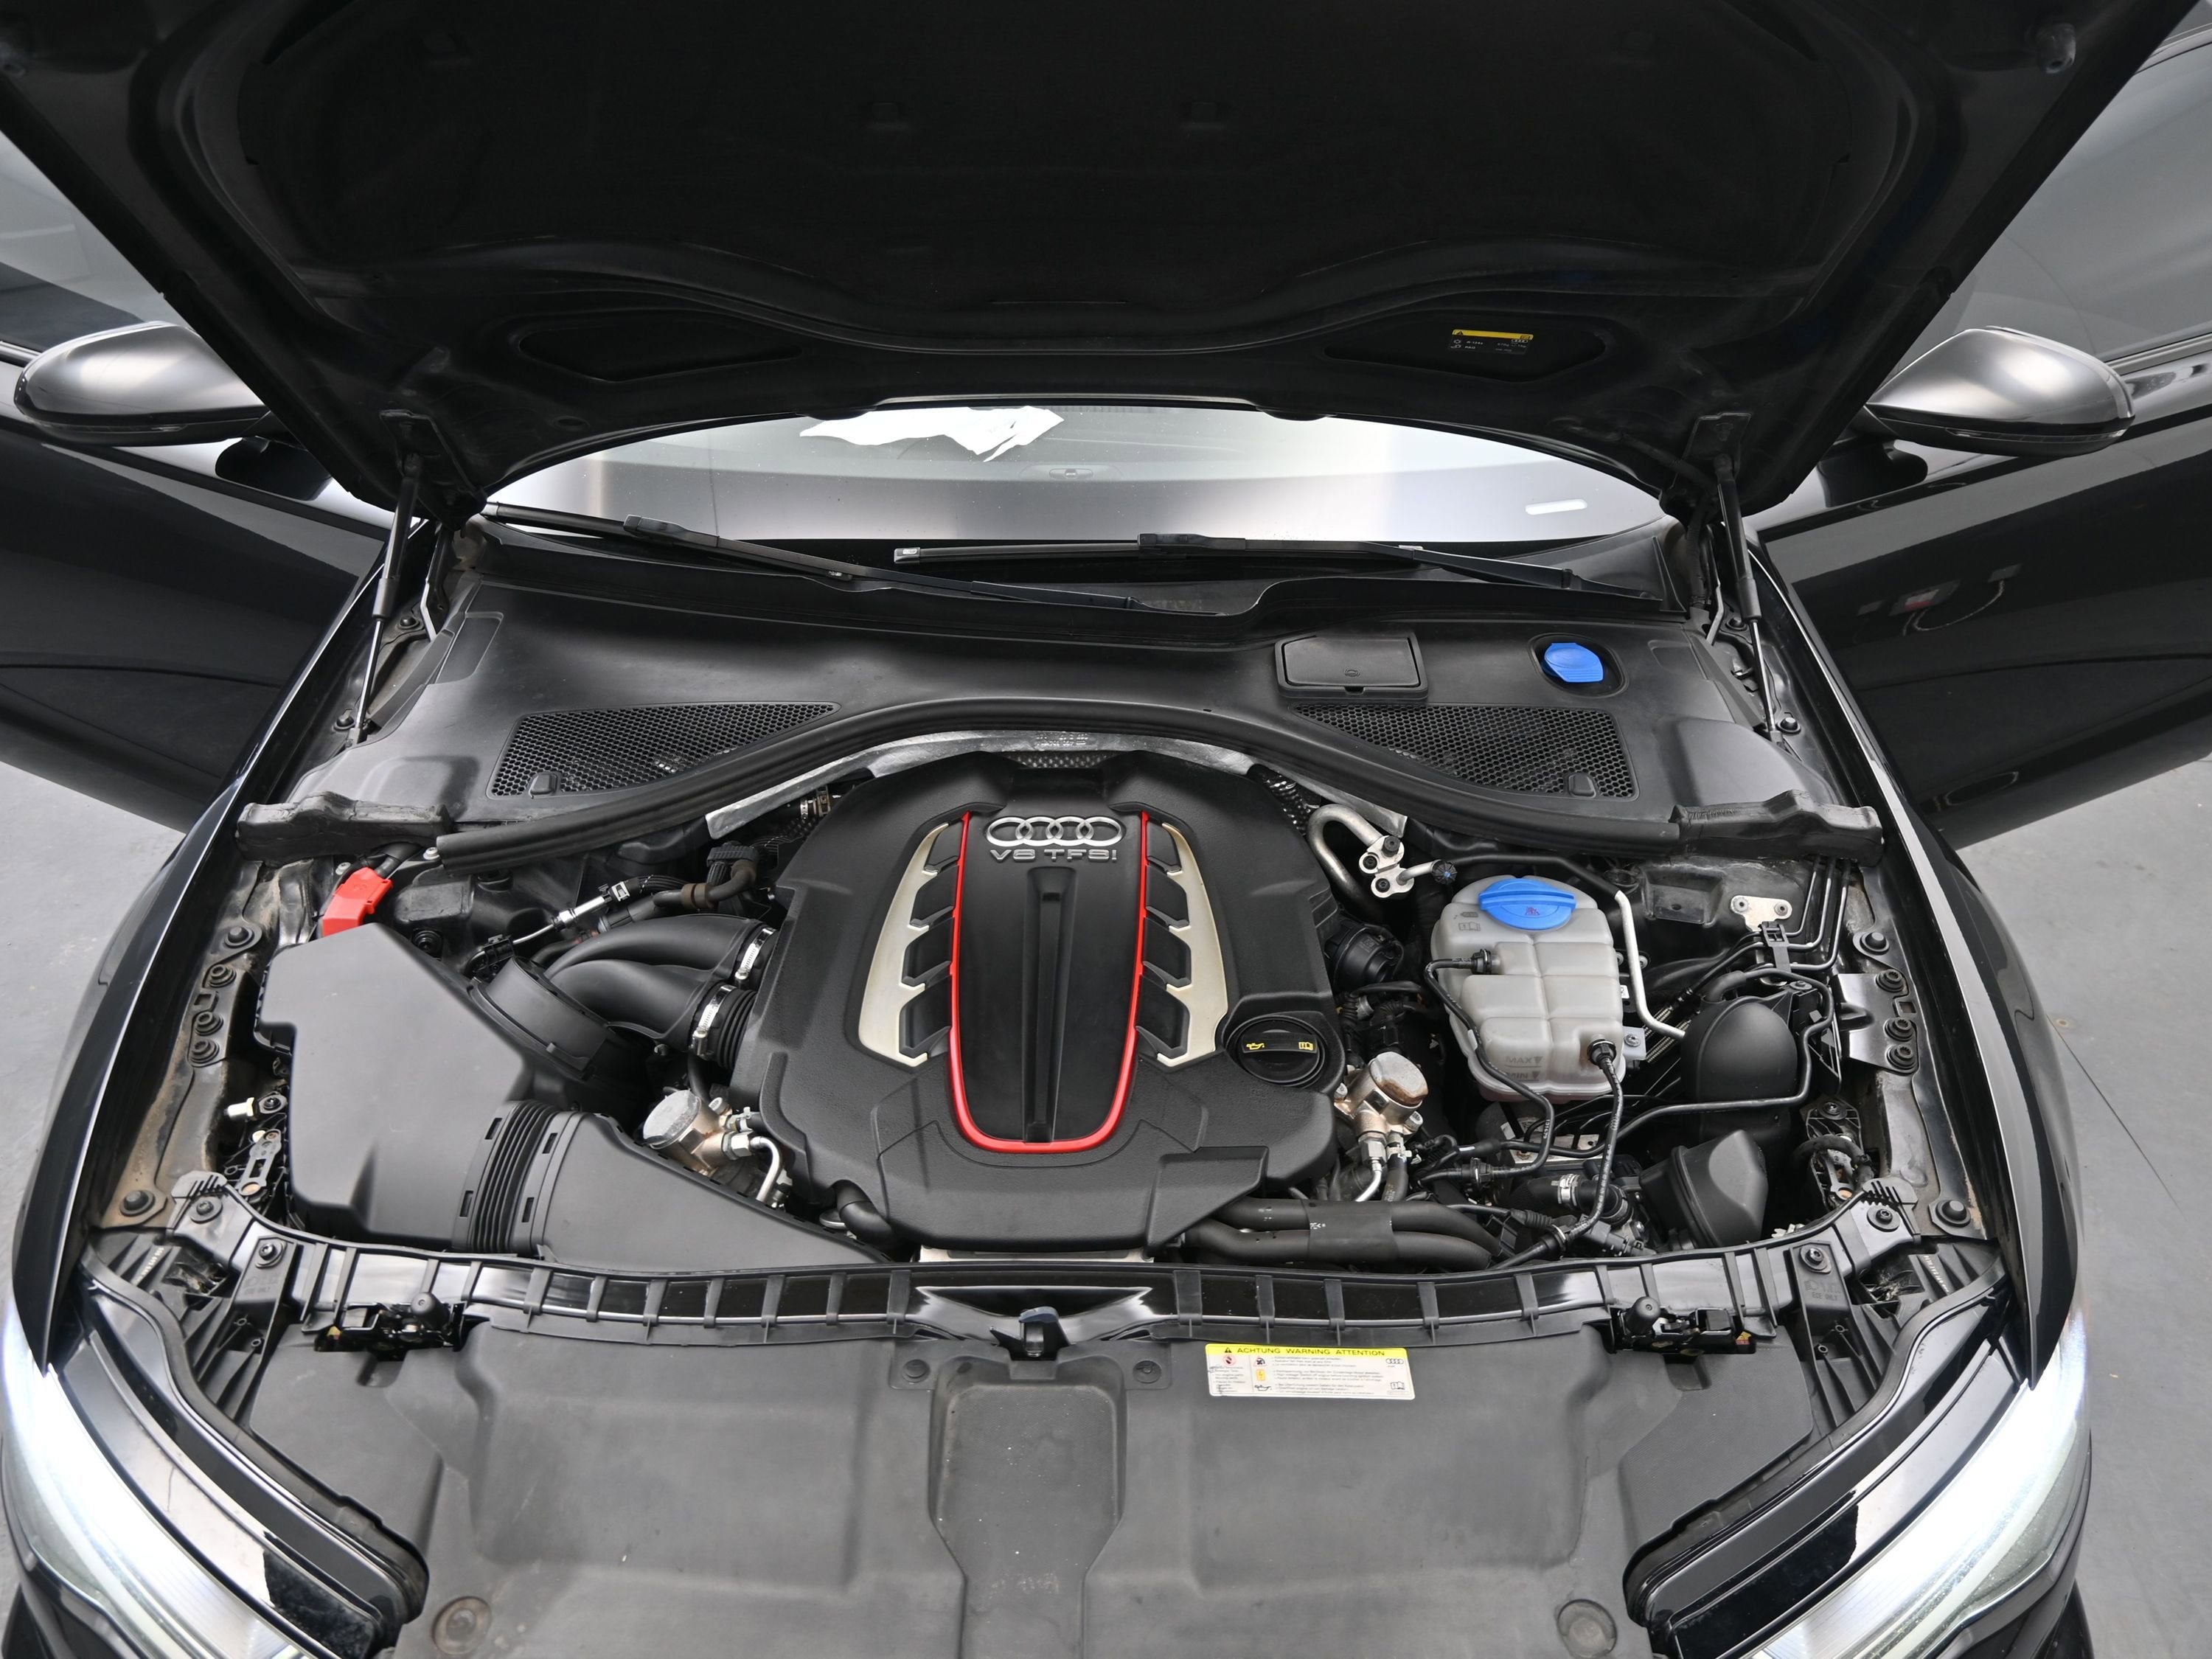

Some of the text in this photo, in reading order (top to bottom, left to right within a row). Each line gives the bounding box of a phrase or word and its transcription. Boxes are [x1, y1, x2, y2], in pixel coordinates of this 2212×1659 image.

[990, 849, 1117, 862] V8 TFSI
[1505, 1055, 1532, 1063] MAX
